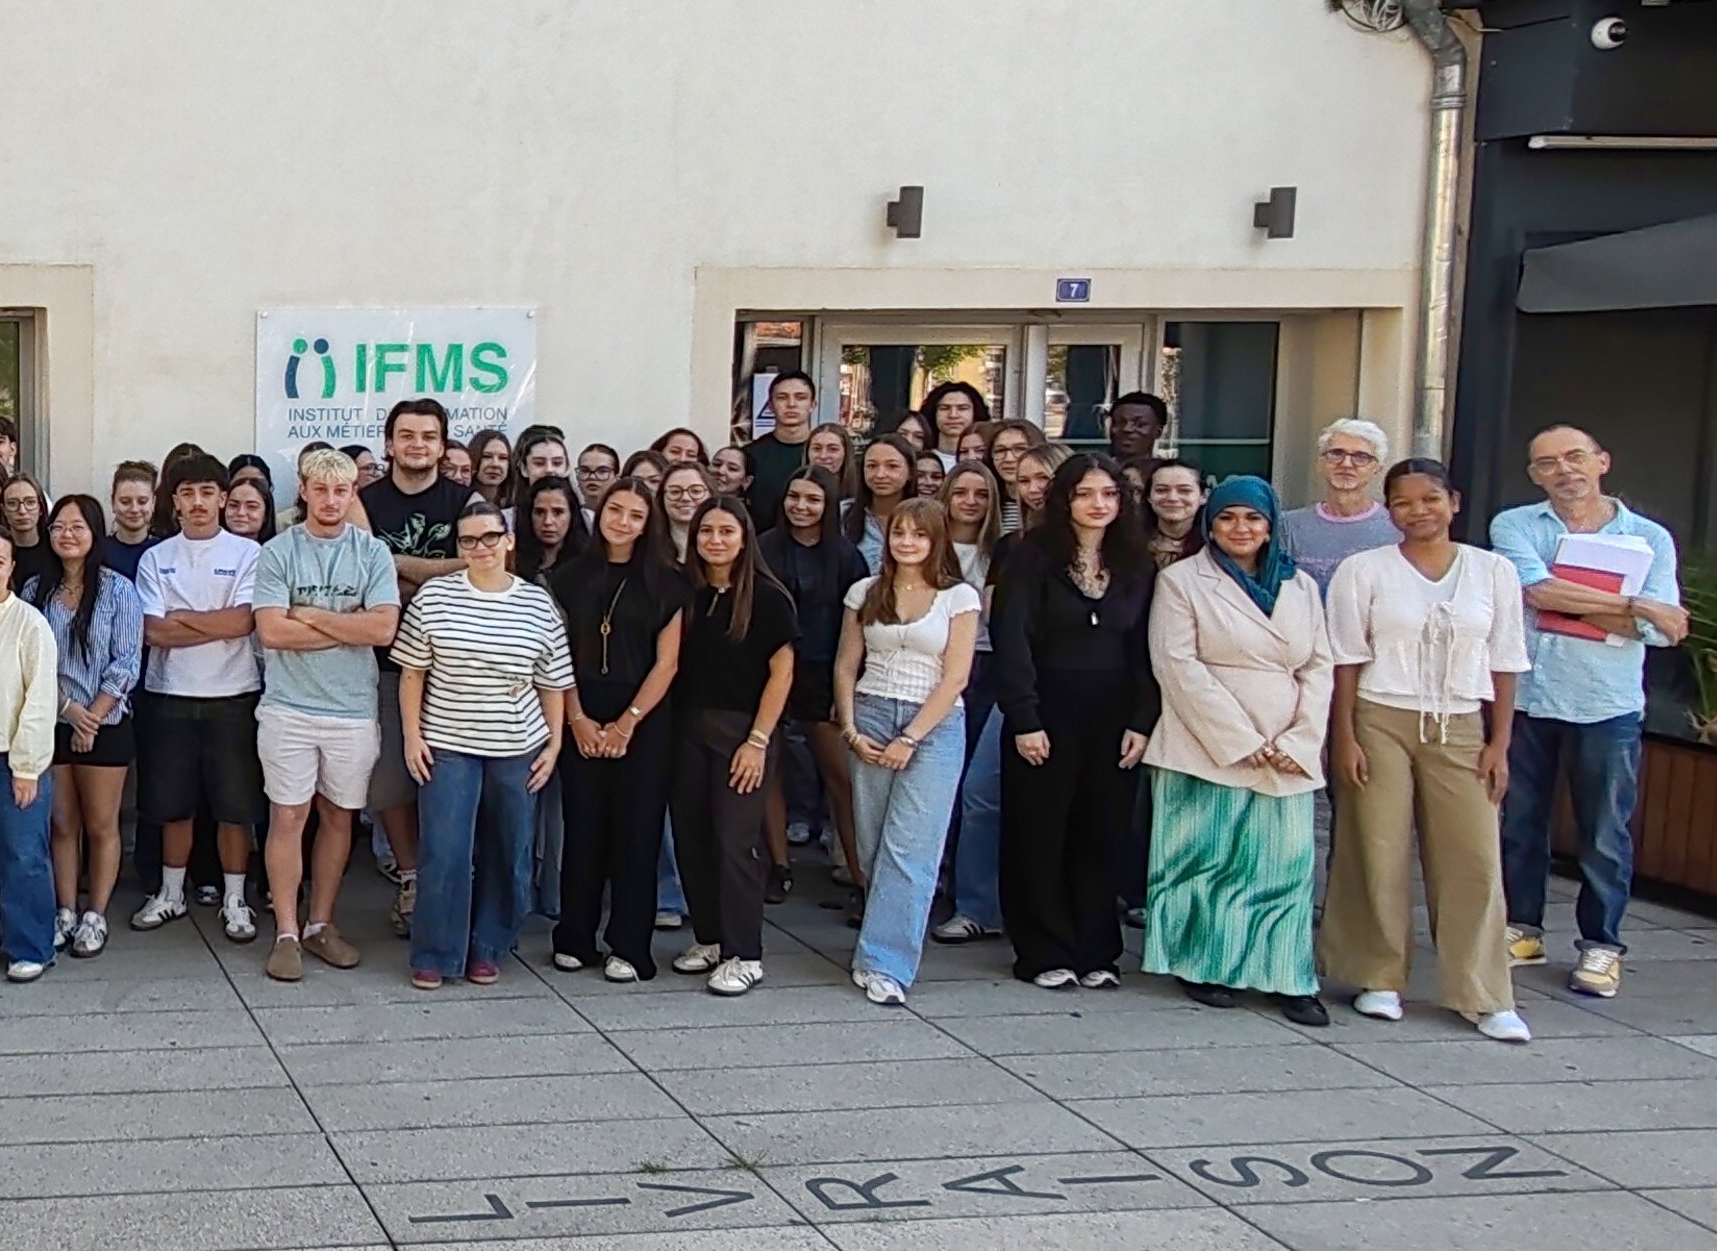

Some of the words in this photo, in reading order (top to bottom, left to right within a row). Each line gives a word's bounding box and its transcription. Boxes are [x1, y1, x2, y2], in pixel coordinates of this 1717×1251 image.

[1070, 283, 1079, 298] 7
[355, 341, 509, 394] IFMS
[289, 407, 363, 421] INSTITUT
[376, 408, 388, 421] D
[288, 425, 321, 438] AUX
[326, 422, 386, 438] MÉTIER
[409, 1146, 1569, 1223] LIVRAISON
